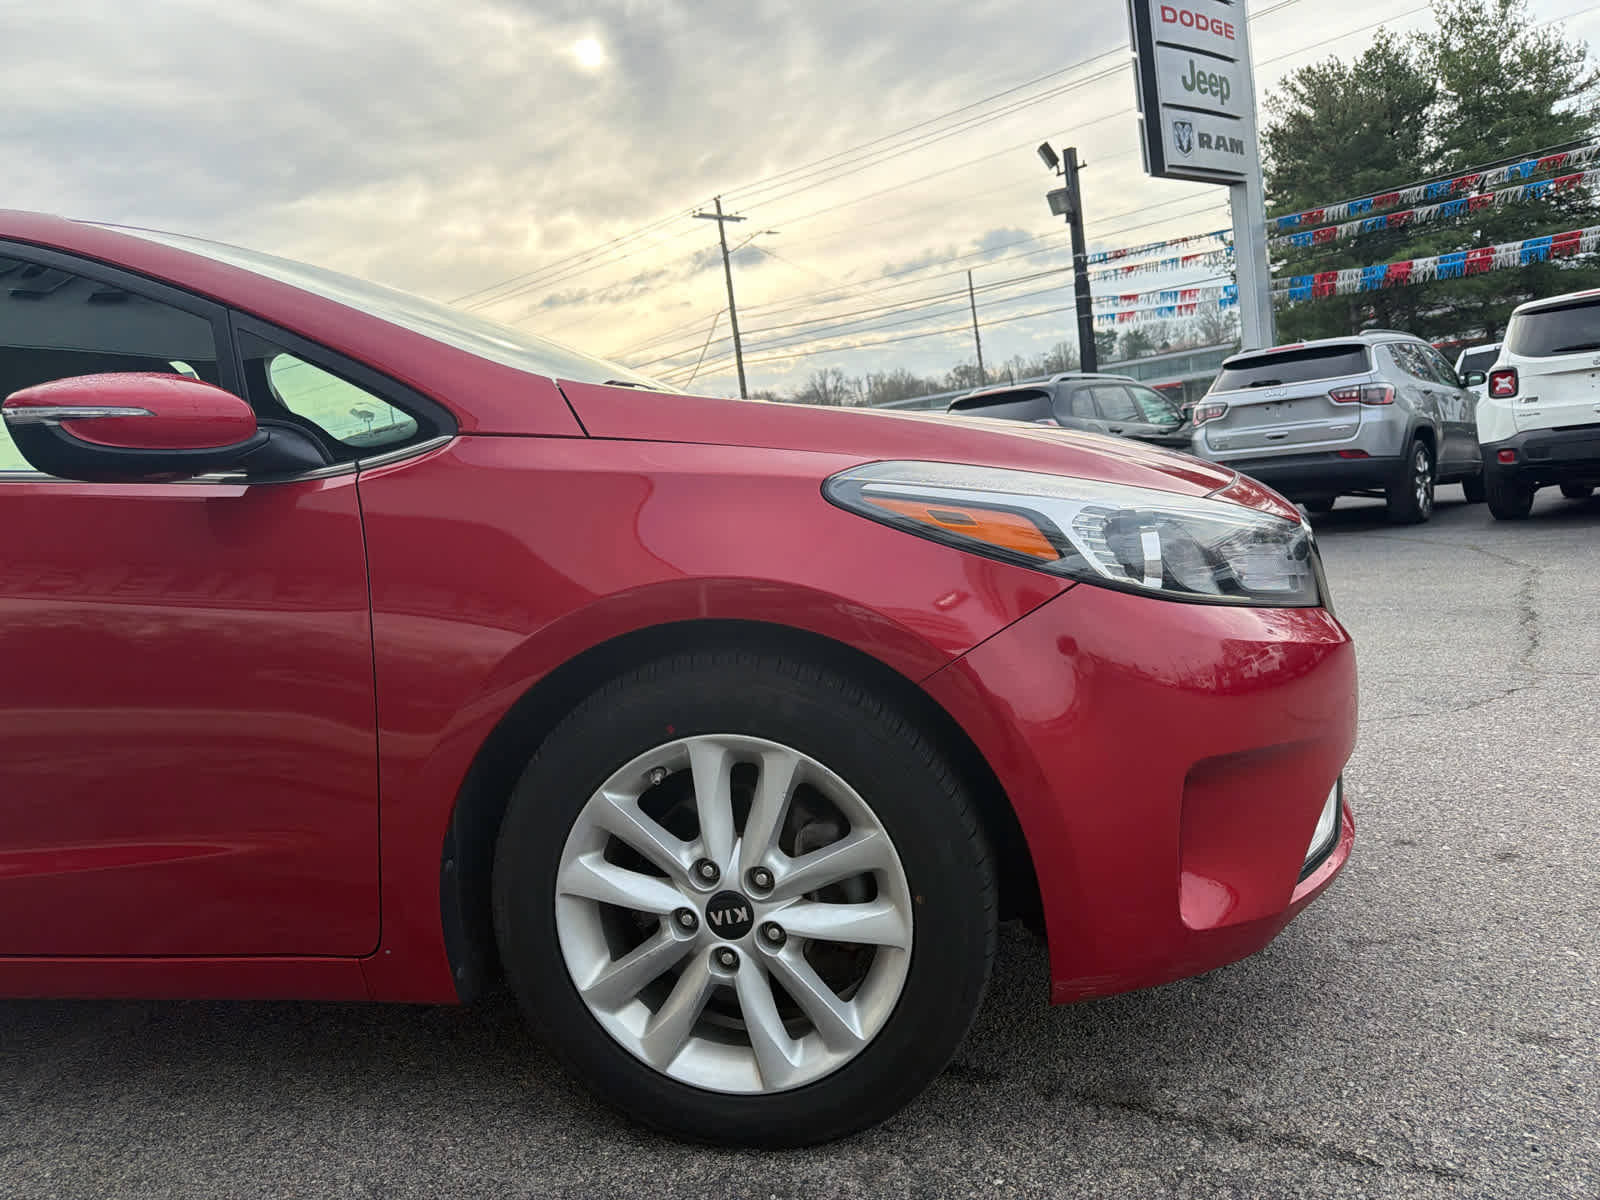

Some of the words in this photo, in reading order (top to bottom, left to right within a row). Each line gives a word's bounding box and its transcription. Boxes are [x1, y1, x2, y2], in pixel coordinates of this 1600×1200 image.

[1160, 5, 1235, 40] DODGE
[1182, 59, 1231, 105] Jeep
[1198, 132, 1245, 155] RAM
[709, 906, 749, 926] KIA
